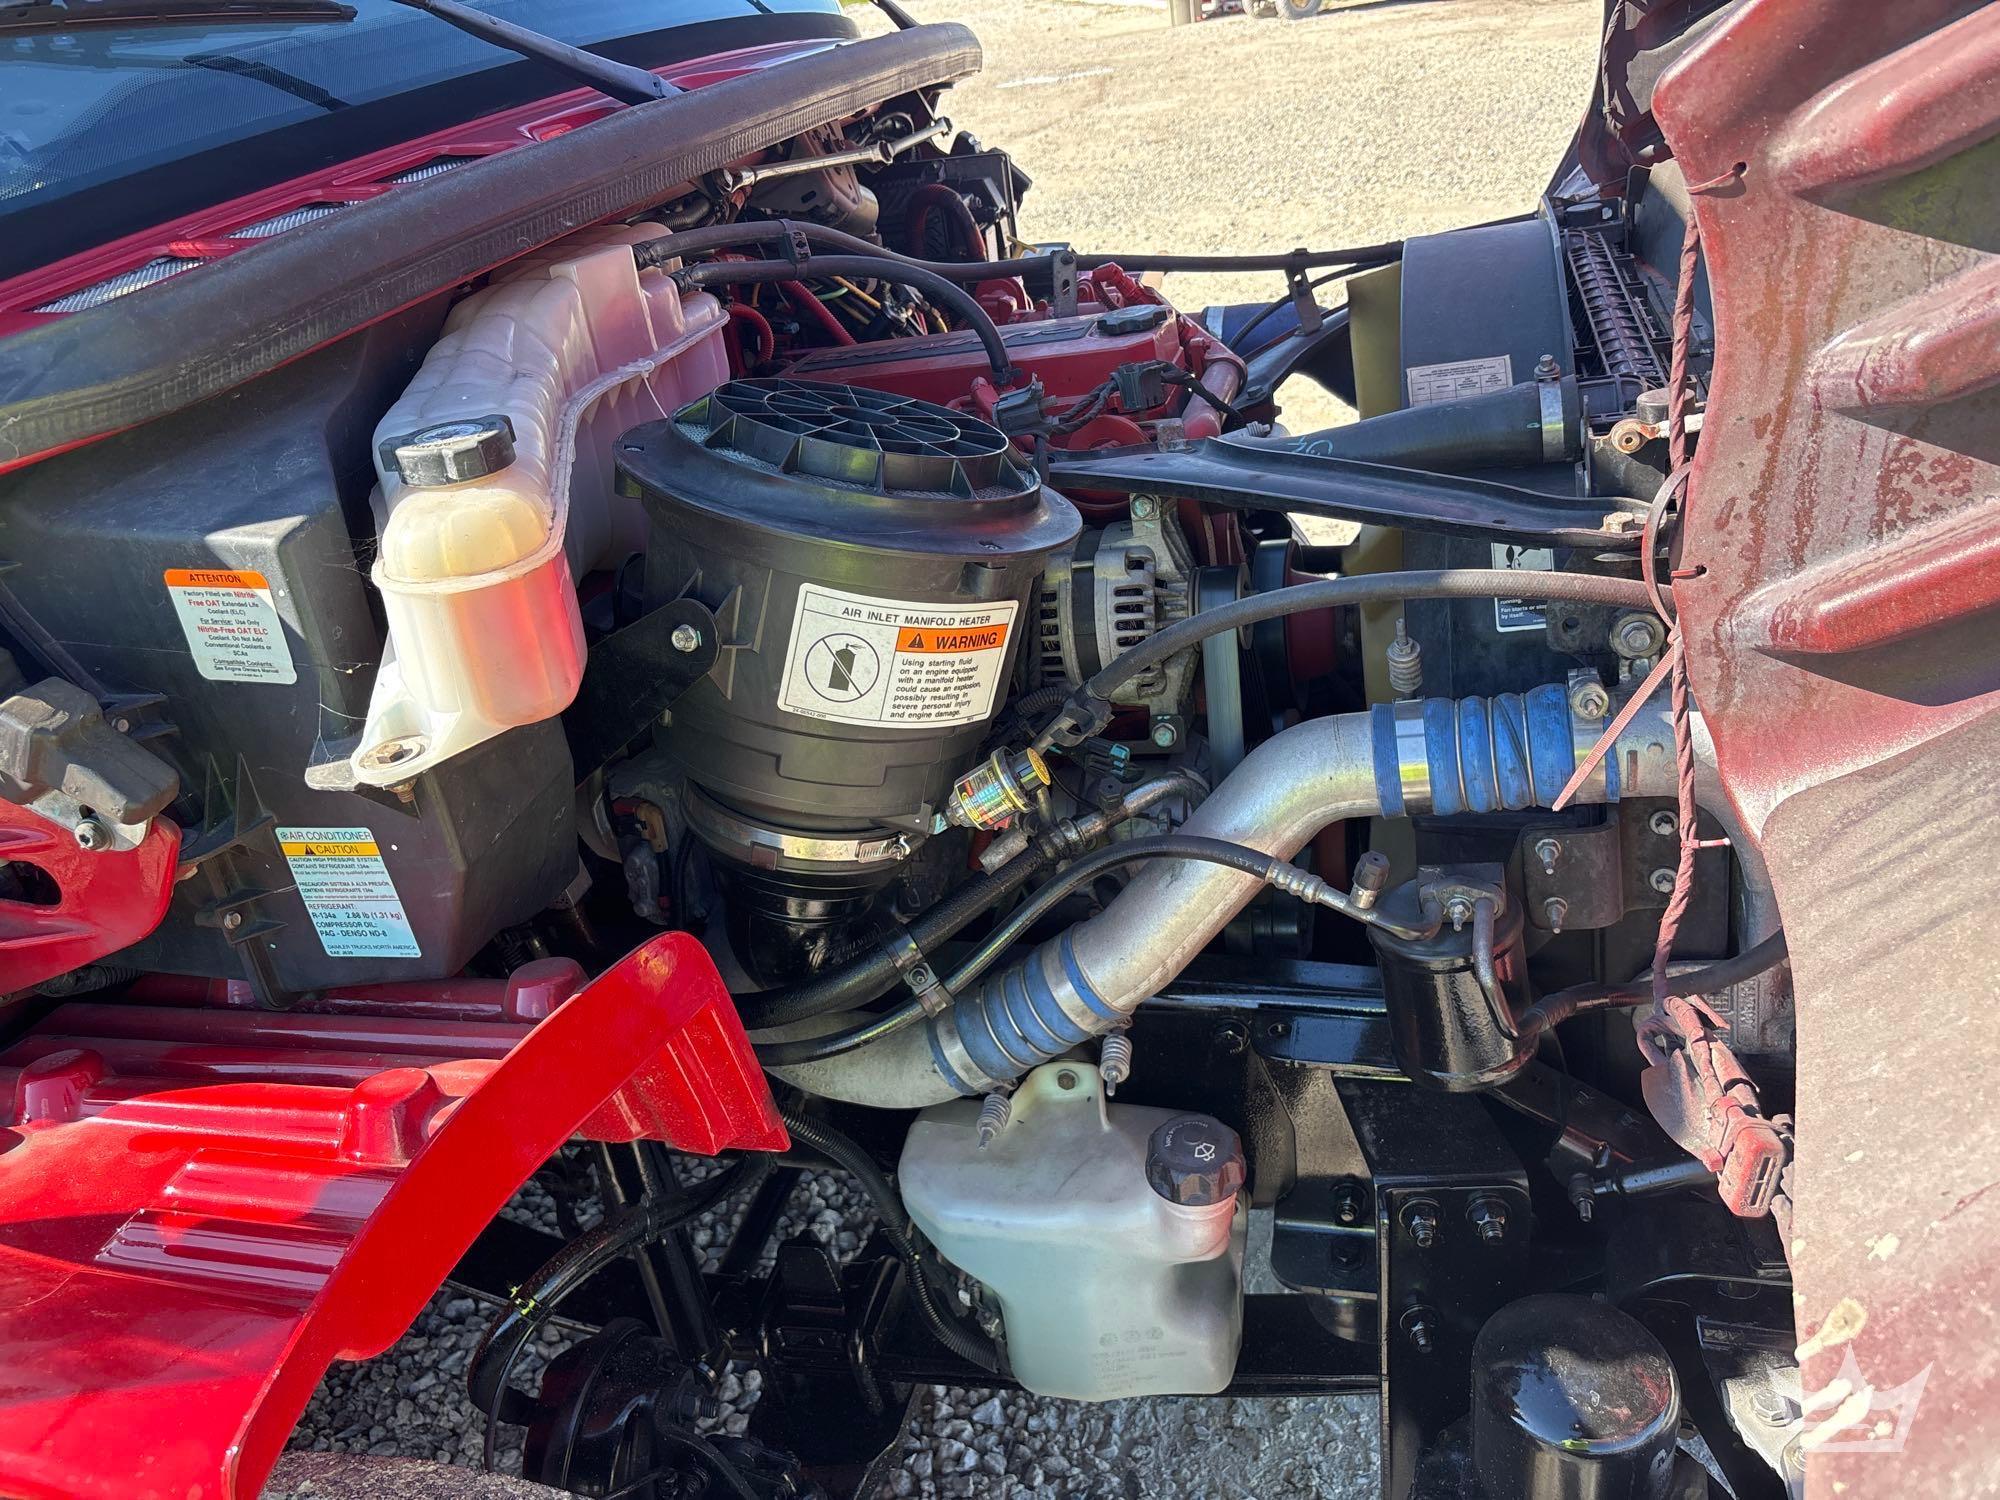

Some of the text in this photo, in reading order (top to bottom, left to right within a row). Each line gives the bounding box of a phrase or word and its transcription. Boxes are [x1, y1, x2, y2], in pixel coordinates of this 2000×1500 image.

[189, 573, 241, 583] ATTENTION
[188, 599, 205, 607] Free
[208, 608, 246, 616] Coolant (ELC)
[841, 606, 992, 627] AIR INLET MANIFOLD HEATER
[197, 626, 237, 634] Nitrite-Free
[237, 626, 252, 635] OAT
[205, 641, 241, 649] Conventional
[936, 632, 998, 650] WARNING
[902, 657, 974, 668] Using starting fluid
[925, 668, 949, 677] engine
[951, 665, 979, 676] equipped
[898, 676, 914, 684] with
[925, 676, 955, 684] manifold
[956, 674, 975, 683] heater
[896, 685, 918, 693] could
[954, 681, 982, 692] explosion,
[894, 693, 928, 702] possibly
[931, 692, 960, 701] resulting
[922, 702, 953, 711] personal
[955, 699, 972, 708] injury
[890, 709, 961, 720] and engine damage.
[289, 831, 372, 841] AIR CONDITIONER
[316, 844, 360, 855] CAUTION
[371, 912, 388, 920] (1.31
[390, 912, 403, 921] kg)
